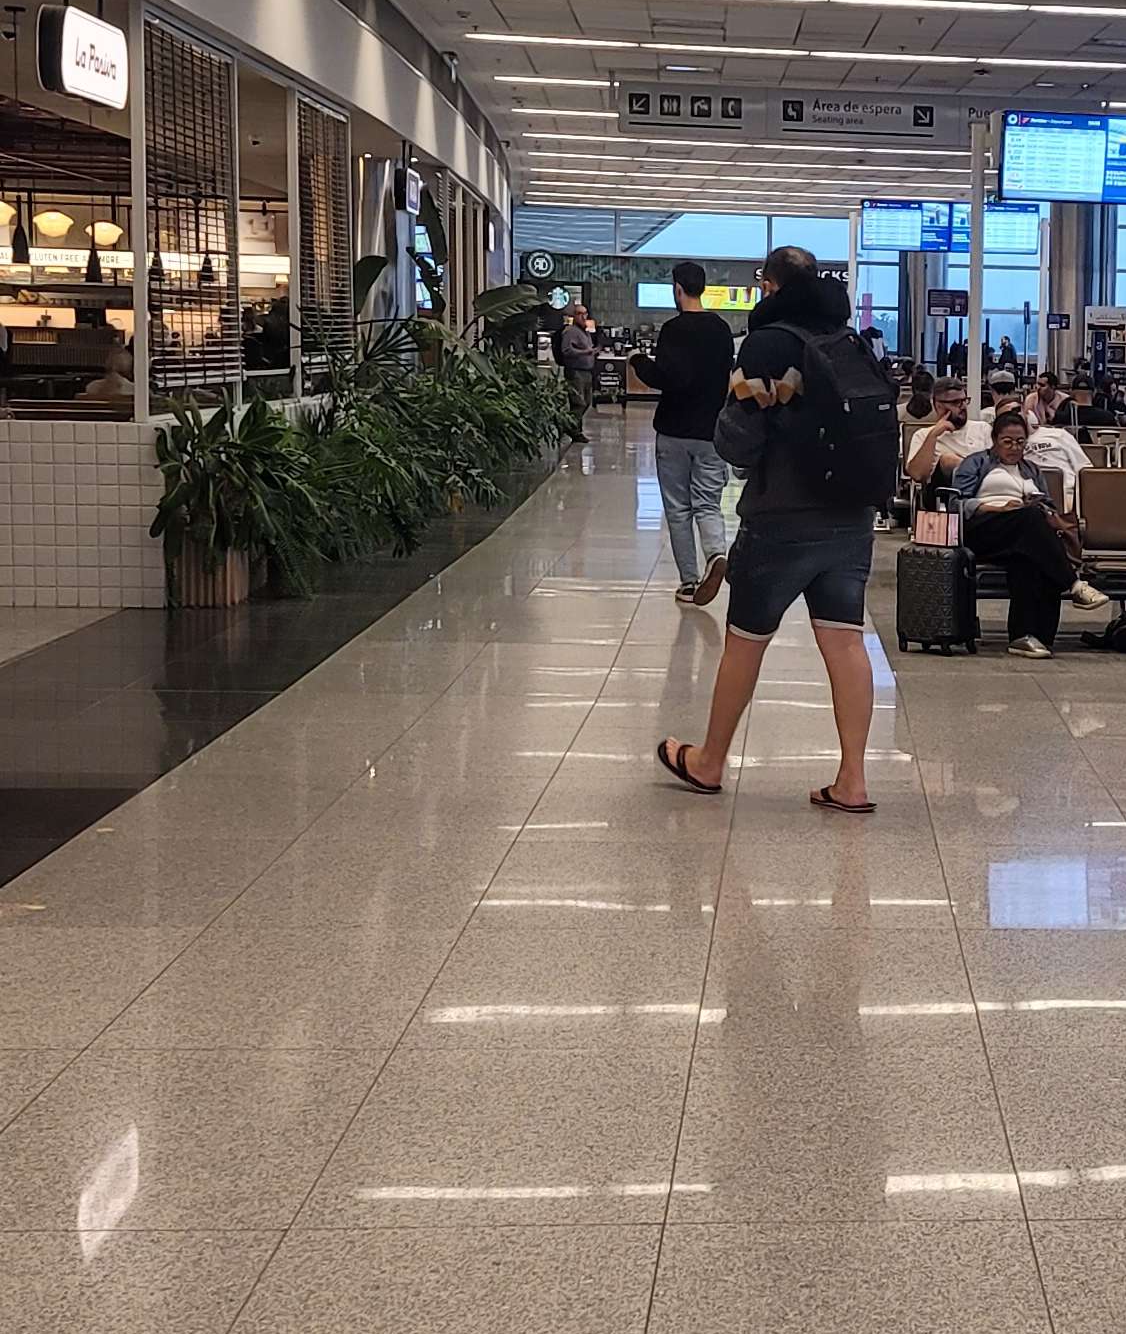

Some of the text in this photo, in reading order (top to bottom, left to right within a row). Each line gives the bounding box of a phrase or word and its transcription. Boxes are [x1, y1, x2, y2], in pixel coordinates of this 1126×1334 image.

[75, 36, 87, 69] La
[843, 100, 859, 113] de
[862, 105, 902, 116] espera
[812, 114, 864, 125] Seating area
